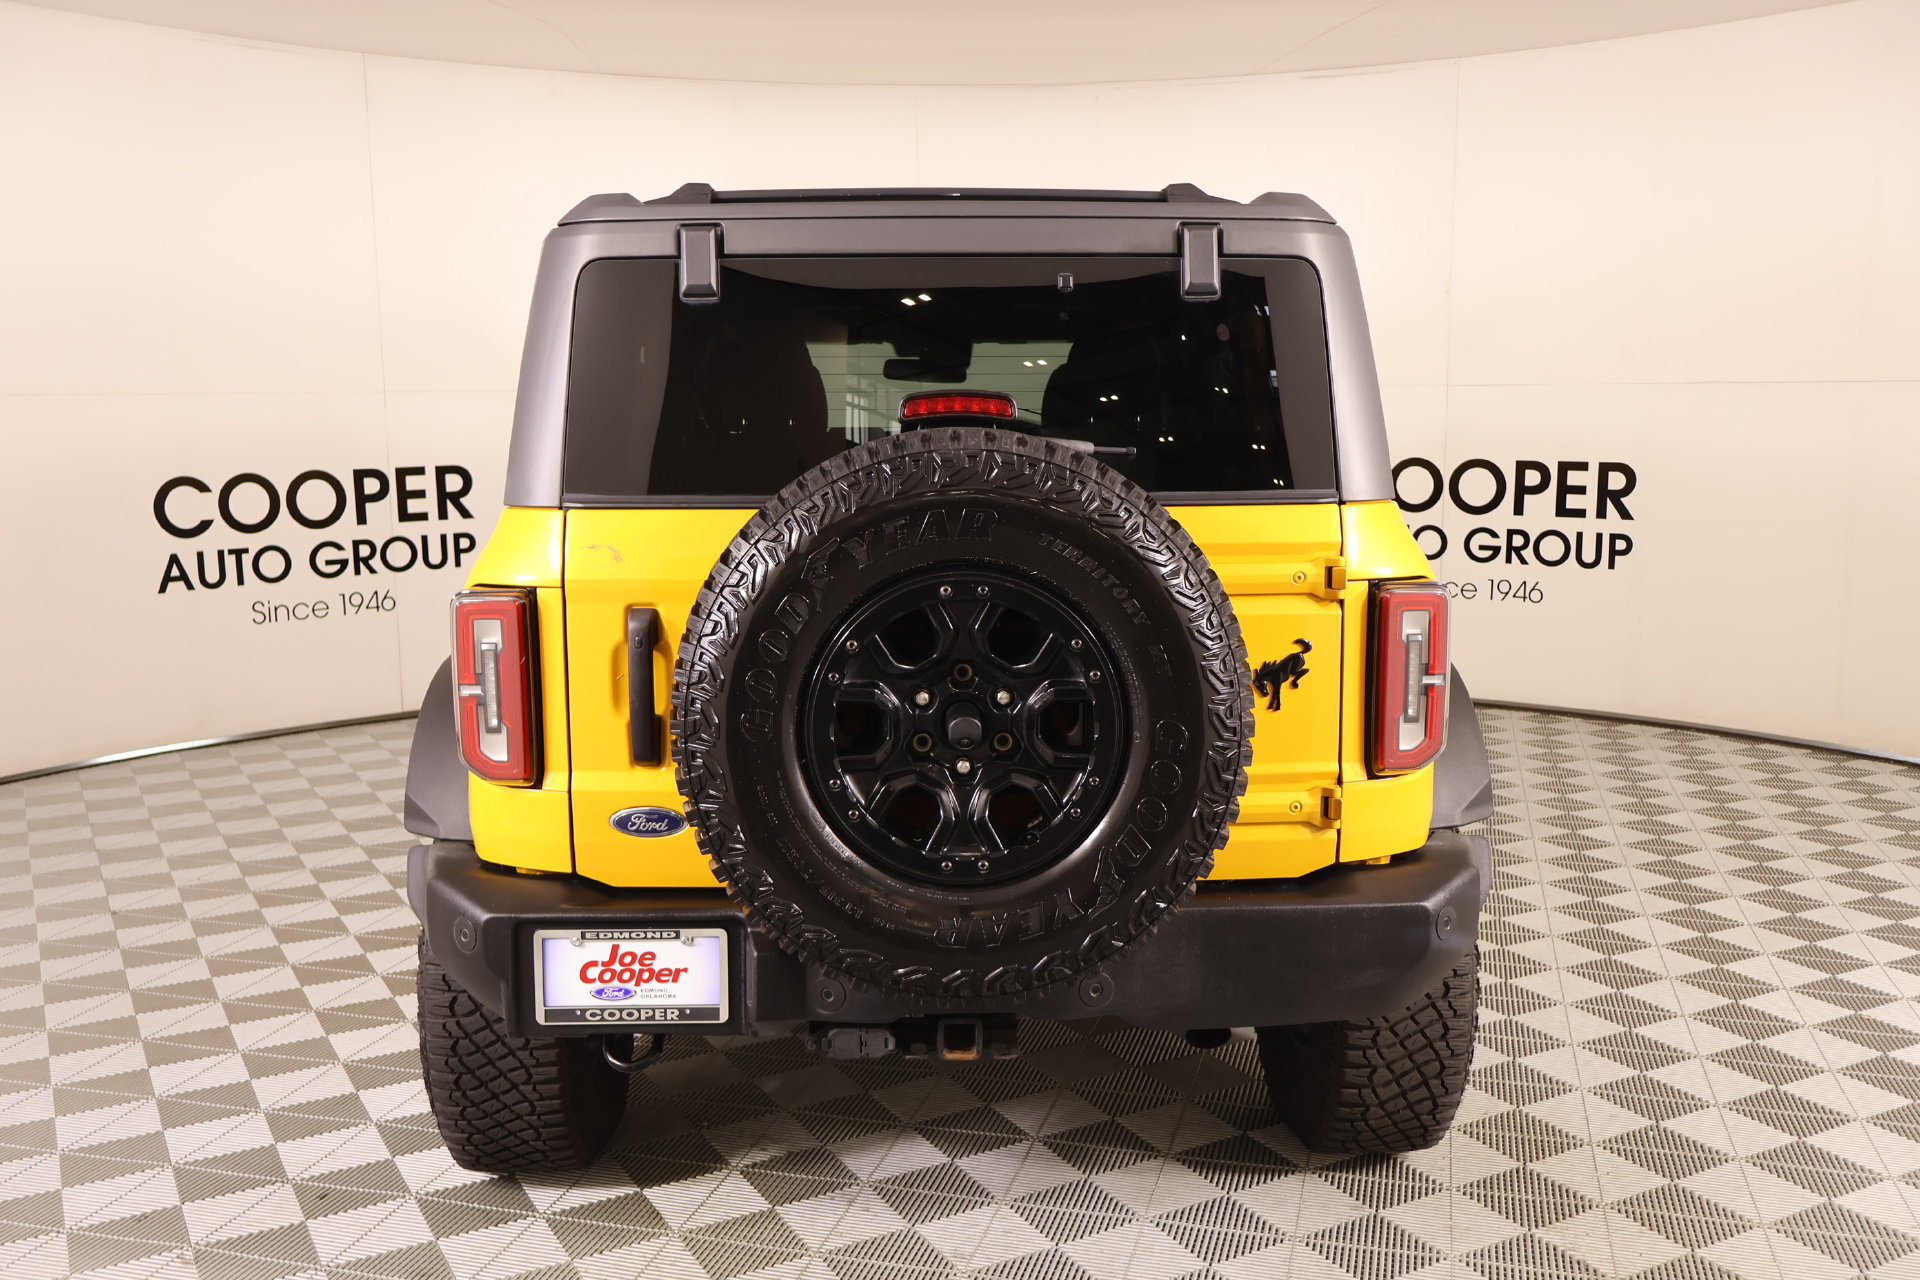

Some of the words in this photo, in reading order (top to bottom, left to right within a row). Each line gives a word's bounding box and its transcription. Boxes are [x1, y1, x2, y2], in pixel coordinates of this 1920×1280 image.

[153, 465, 475, 539] COOPER
[1391, 457, 1637, 521] OOPER
[1463, 527, 1634, 570] GROUP
[157, 545, 292, 594] AUTO
[309, 532, 477, 579] GROUP
[1488, 579, 1544, 604] 1946
[251, 599, 330, 625] Since
[338, 589, 396, 616] 1946
[627, 813, 669, 832] Ford
[585, 931, 677, 940] EDMOND
[601, 944, 657, 968] Joe
[579, 960, 689, 987] Cooper
[585, 1008, 680, 1021] COOPER
